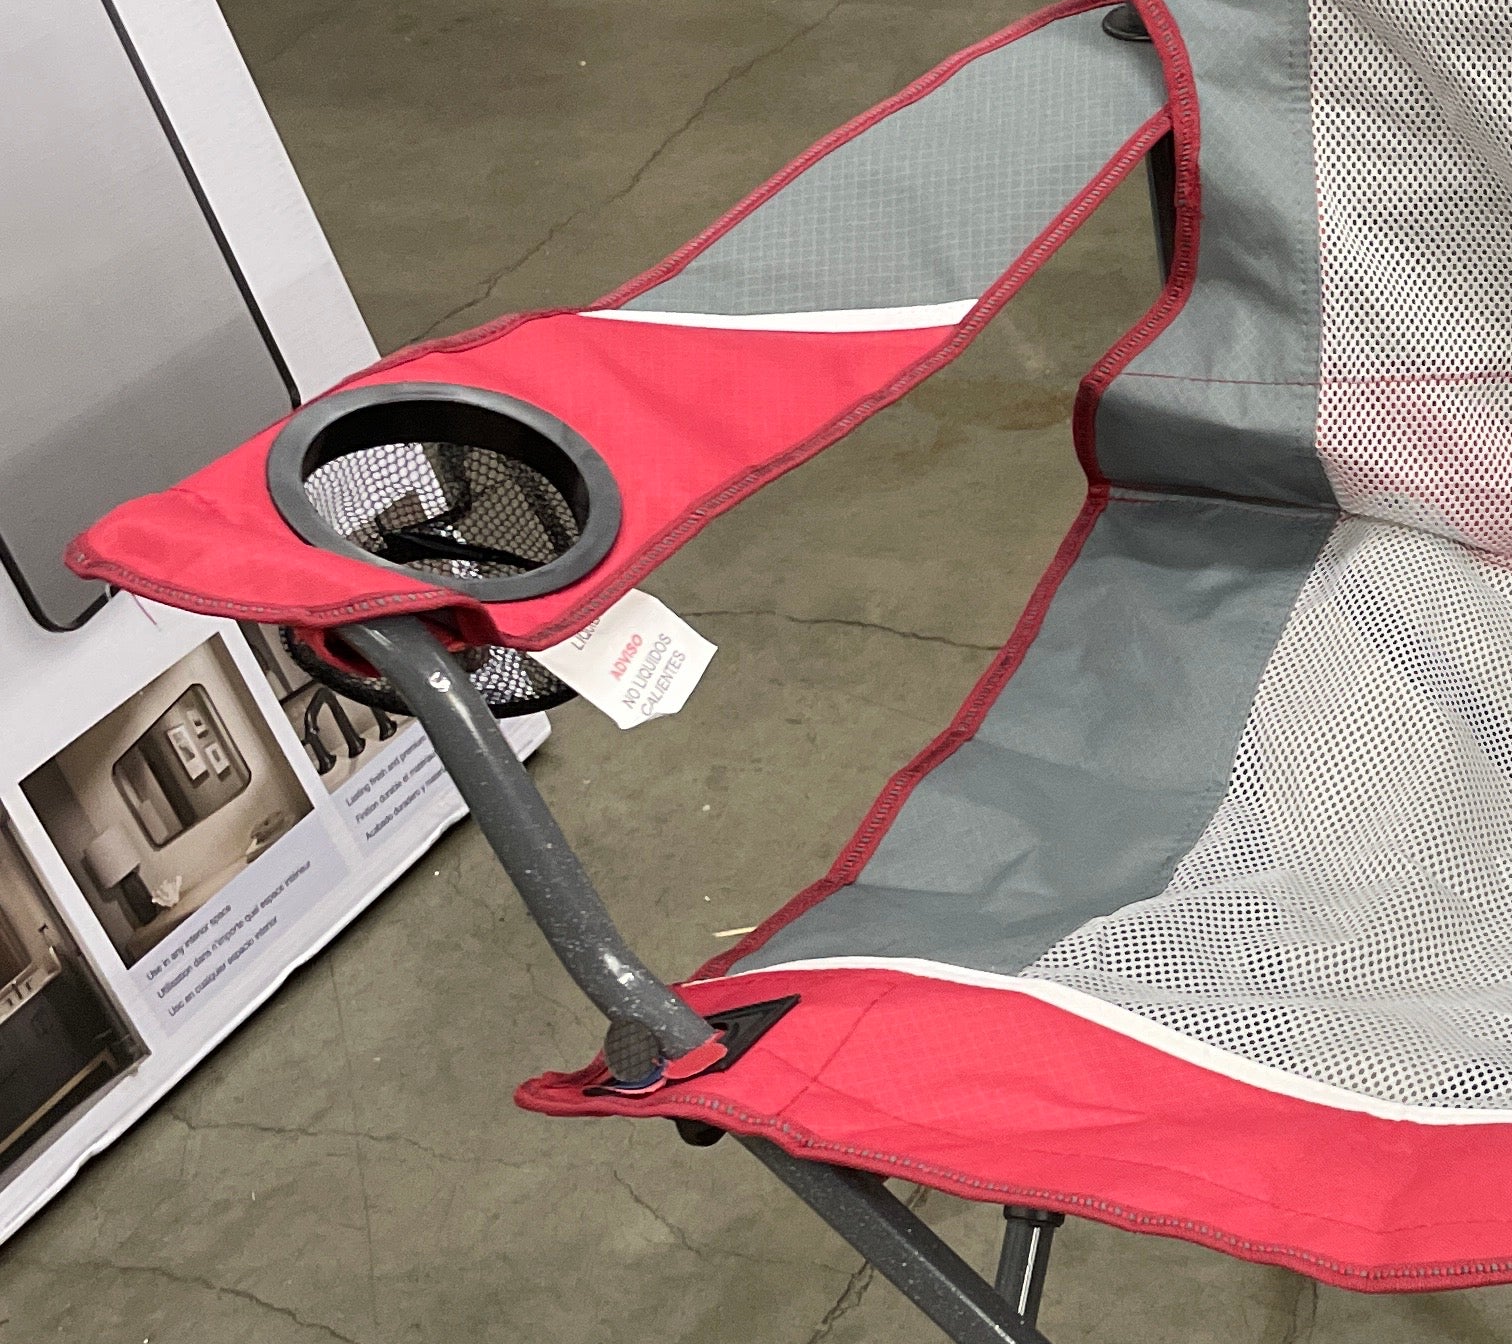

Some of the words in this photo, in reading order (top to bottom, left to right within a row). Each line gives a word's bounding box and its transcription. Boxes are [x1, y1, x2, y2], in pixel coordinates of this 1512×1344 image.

[610, 634, 643, 681] ADVISO
[622, 687, 641, 710] NO
[635, 633, 672, 689] LIQUIDOS
[641, 650, 686, 716] CALIENTES
[147, 965, 162, 980] Use
[162, 958, 171, 967] in
[170, 946, 184, 960] any
